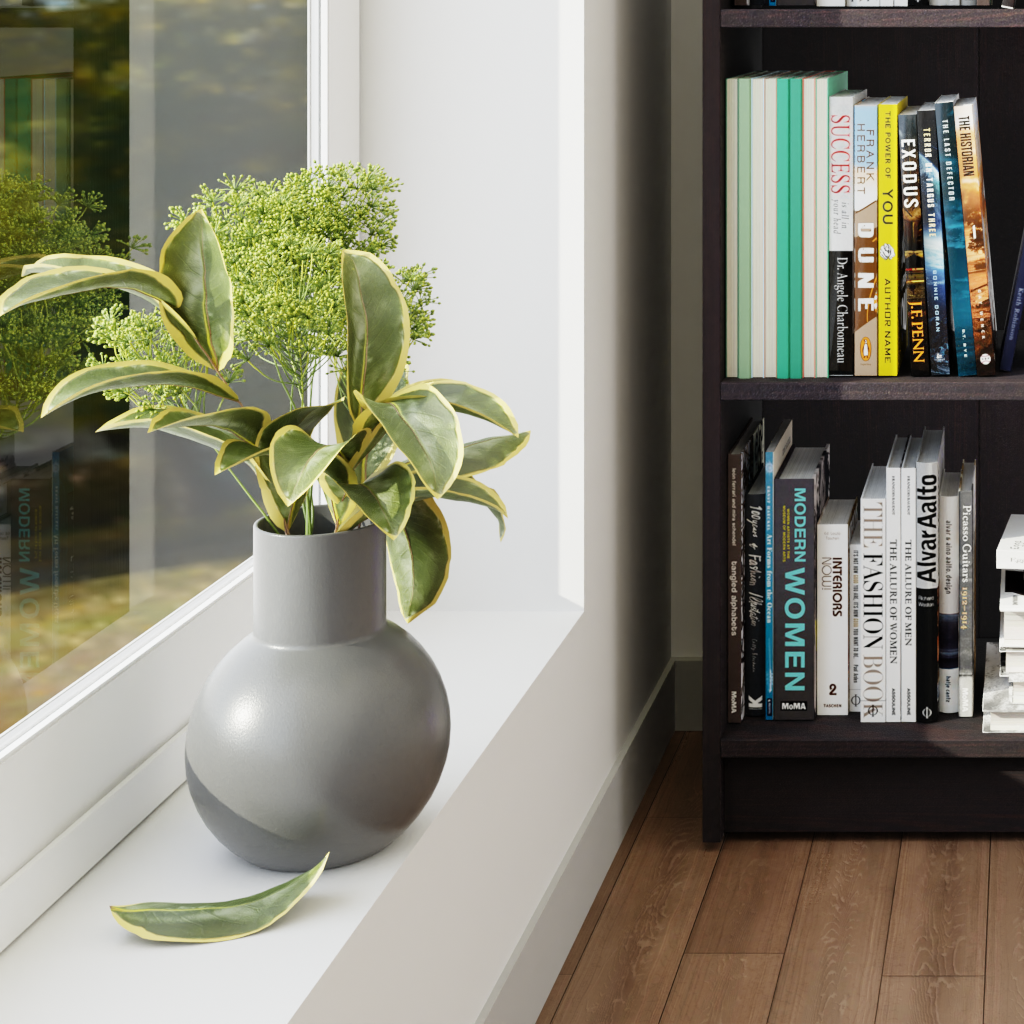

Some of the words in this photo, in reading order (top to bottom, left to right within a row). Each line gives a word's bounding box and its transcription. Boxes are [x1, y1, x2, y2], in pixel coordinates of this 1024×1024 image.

[941, 119, 949, 136] THE
[958, 115, 970, 131] THE
[830, 114, 851, 194] SUCCESS
[856, 123, 866, 195] HERBERT
[866, 129, 875, 182] FRANK
[943, 138, 952, 158] LAST
[960, 133, 974, 177] HISTORIAN
[885, 167, 891, 180] OF
[900, 138, 919, 209] EXODUS
[945, 161, 956, 202] DEFECTOR
[882, 189, 893, 225] YOU
[836, 257, 847, 270] Dr.
[857, 222, 875, 313] DUNE
[834, 272, 847, 302] Angele
[908, 301, 923, 320] J.F.
[836, 304, 848, 364] Charbonneau
[910, 320, 925, 363] PENN
[793, 487, 806, 562] MODERN
[863, 502, 883, 547] THE
[961, 505, 972, 541] Picasso
[889, 539, 898, 561] THE
[904, 539, 912, 561] THE
[961, 543, 972, 583] Guitars
[832, 557, 842, 617] INTERIORS
[863, 554, 883, 650] FASHION
[889, 563, 898, 605] ALLURE
[904, 563, 912, 605] ALLURE
[784, 567, 805, 691] WOMEN
[889, 607, 898, 620] OF
[904, 607, 912, 620] OF
[889, 623, 898, 664] WOMEN
[904, 623, 912, 646] MEN
[781, 702, 807, 710] MoMA
[863, 656, 883, 717] BOOK
